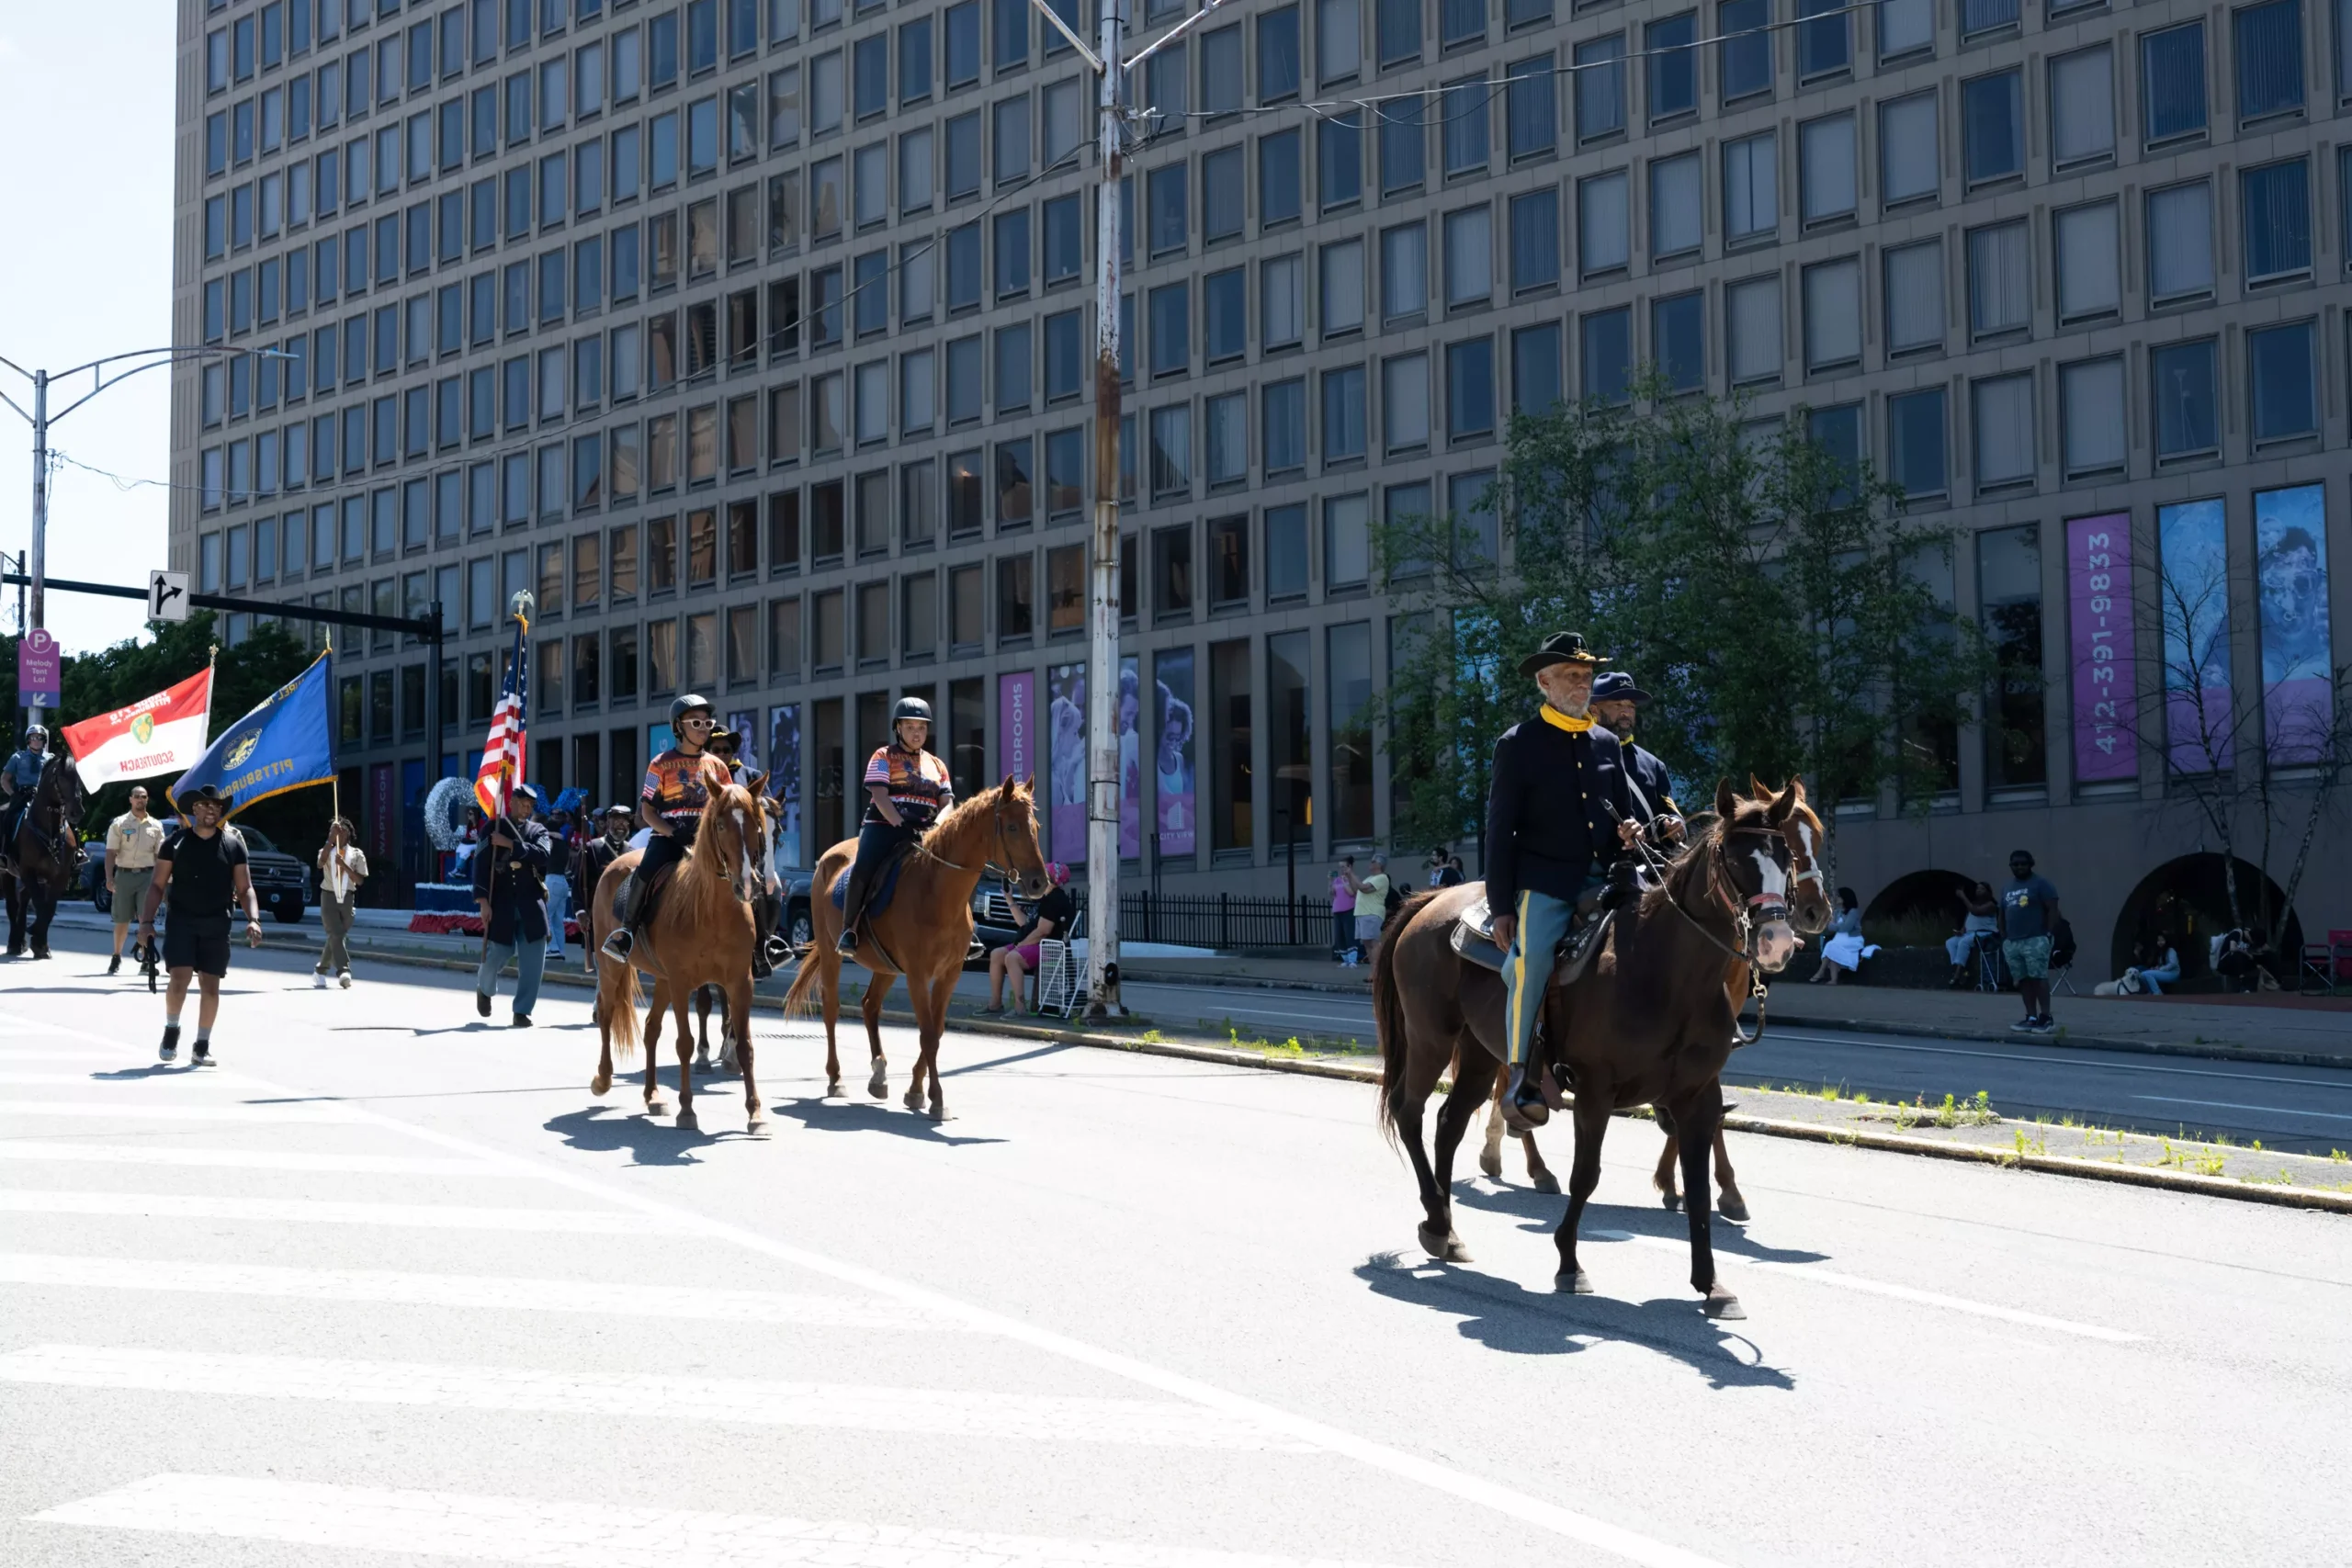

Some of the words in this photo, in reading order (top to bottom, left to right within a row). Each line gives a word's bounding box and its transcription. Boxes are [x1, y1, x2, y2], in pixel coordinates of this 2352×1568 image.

[34, 633, 47, 648] P
[2087, 532, 2117, 755] 412-391-9833
[26, 659, 52, 669] Melody
[32, 667, 48, 675] Tent
[1013, 682, 1023, 783] BEDROOMS
